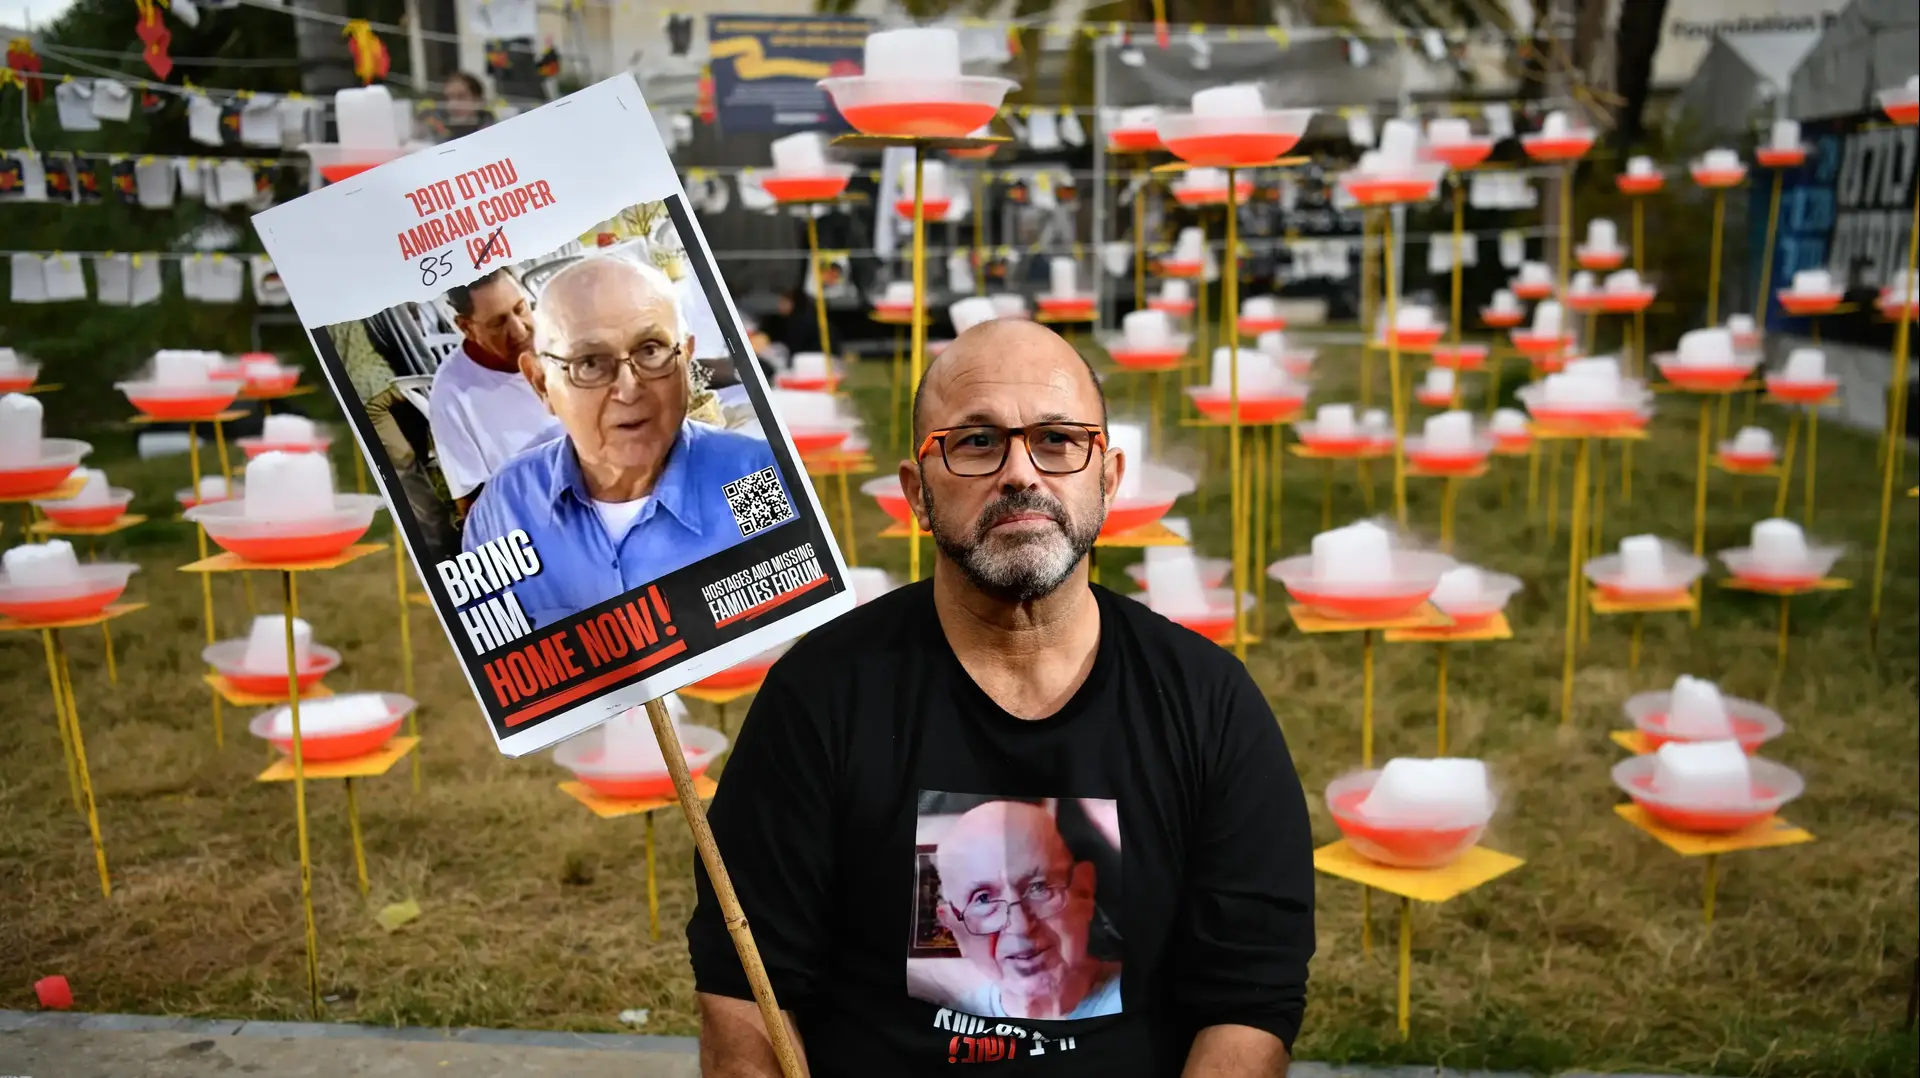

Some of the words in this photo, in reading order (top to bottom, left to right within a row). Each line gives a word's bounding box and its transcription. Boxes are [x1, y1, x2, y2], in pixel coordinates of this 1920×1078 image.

[404, 180, 456, 217] קופר
[455, 158, 518, 200] עמירם
[398, 206, 480, 260] AMIRAM
[478, 179, 556, 227] COOPER
[420, 250, 453, 286] 85
[436, 529, 540, 607] BRING
[701, 569, 753, 601] HOSTAGES
[753, 560, 773, 581] AND
[771, 542, 815, 572] MISSING
[708, 578, 775, 623] FAMILIES
[773, 558, 824, 596] FORUM
[459, 591, 532, 656] HIM
[484, 631, 584, 707] HOME
[575, 585, 677, 667] NOW!
